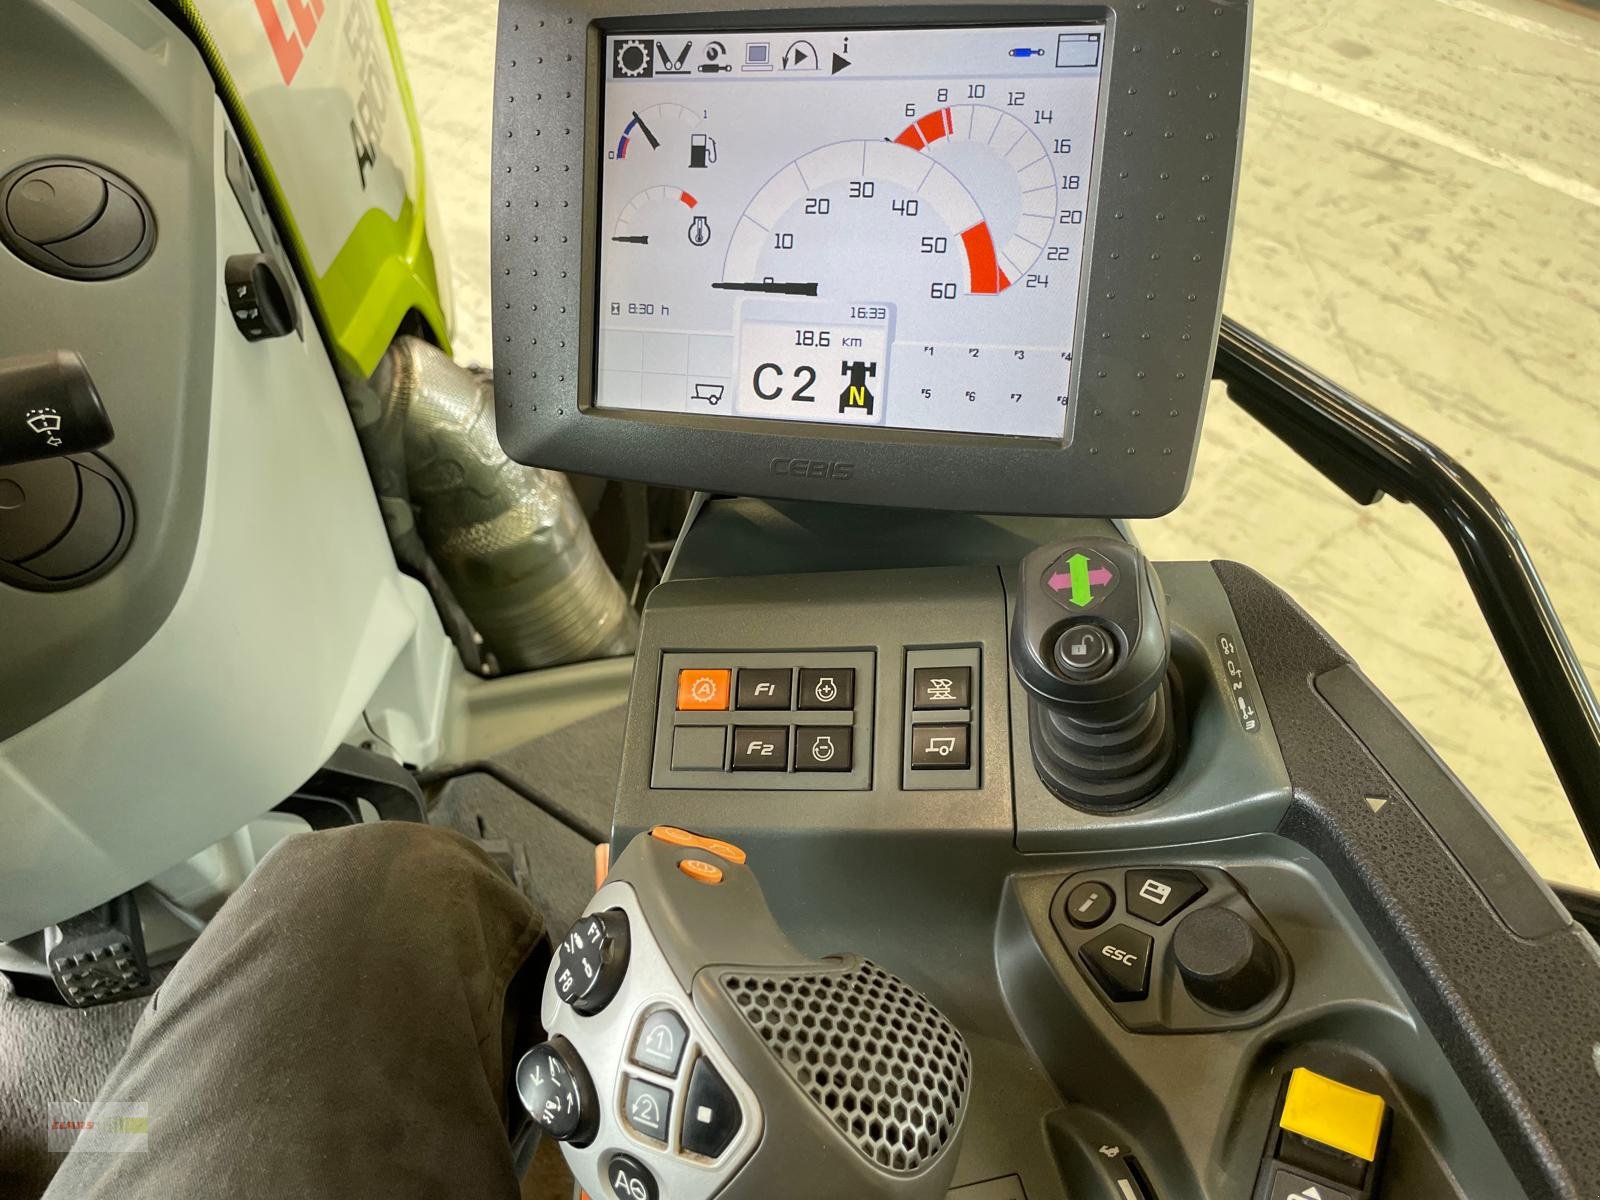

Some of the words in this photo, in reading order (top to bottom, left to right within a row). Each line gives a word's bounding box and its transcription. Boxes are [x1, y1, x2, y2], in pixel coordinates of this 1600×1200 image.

[937, 88, 948, 102] 8
[968, 84, 985, 98] 10
[1007, 92, 1025, 106] 12
[905, 103, 916, 117] 6
[1034, 110, 1053, 124] 14
[1053, 139, 1072, 153] 16
[849, 182, 874, 198] 30
[1062, 176, 1080, 190] 18
[805, 198, 830, 215] 20
[892, 200, 918, 216] 40
[1060, 210, 1082, 224] 20
[774, 233, 794, 249] 10
[921, 237, 947, 254] 50
[1046, 247, 1069, 261] 22
[1026, 274, 1049, 288] 24
[930, 282, 957, 299] 60
[628, 303, 655, 315] 8:30
[661, 304, 670, 316] h
[850, 306, 886, 320] 16:33
[795, 330, 830, 347] 18.6
[924, 346, 934, 356] F1
[968, 348, 979, 358] F2
[1014, 350, 1025, 360] F3
[849, 385, 865, 406] N
[921, 388, 932, 399] F5
[965, 391, 976, 401] F6
[1010, 393, 1022, 403] F7
[769, 457, 855, 480] CEBIS
[754, 682, 776, 696] F1
[746, 741, 775, 756] F2
[587, 921, 601, 944] F7
[1101, 945, 1138, 967] ESC
[558, 968, 573, 992] F8
[640, 1098, 652, 1120] 2
